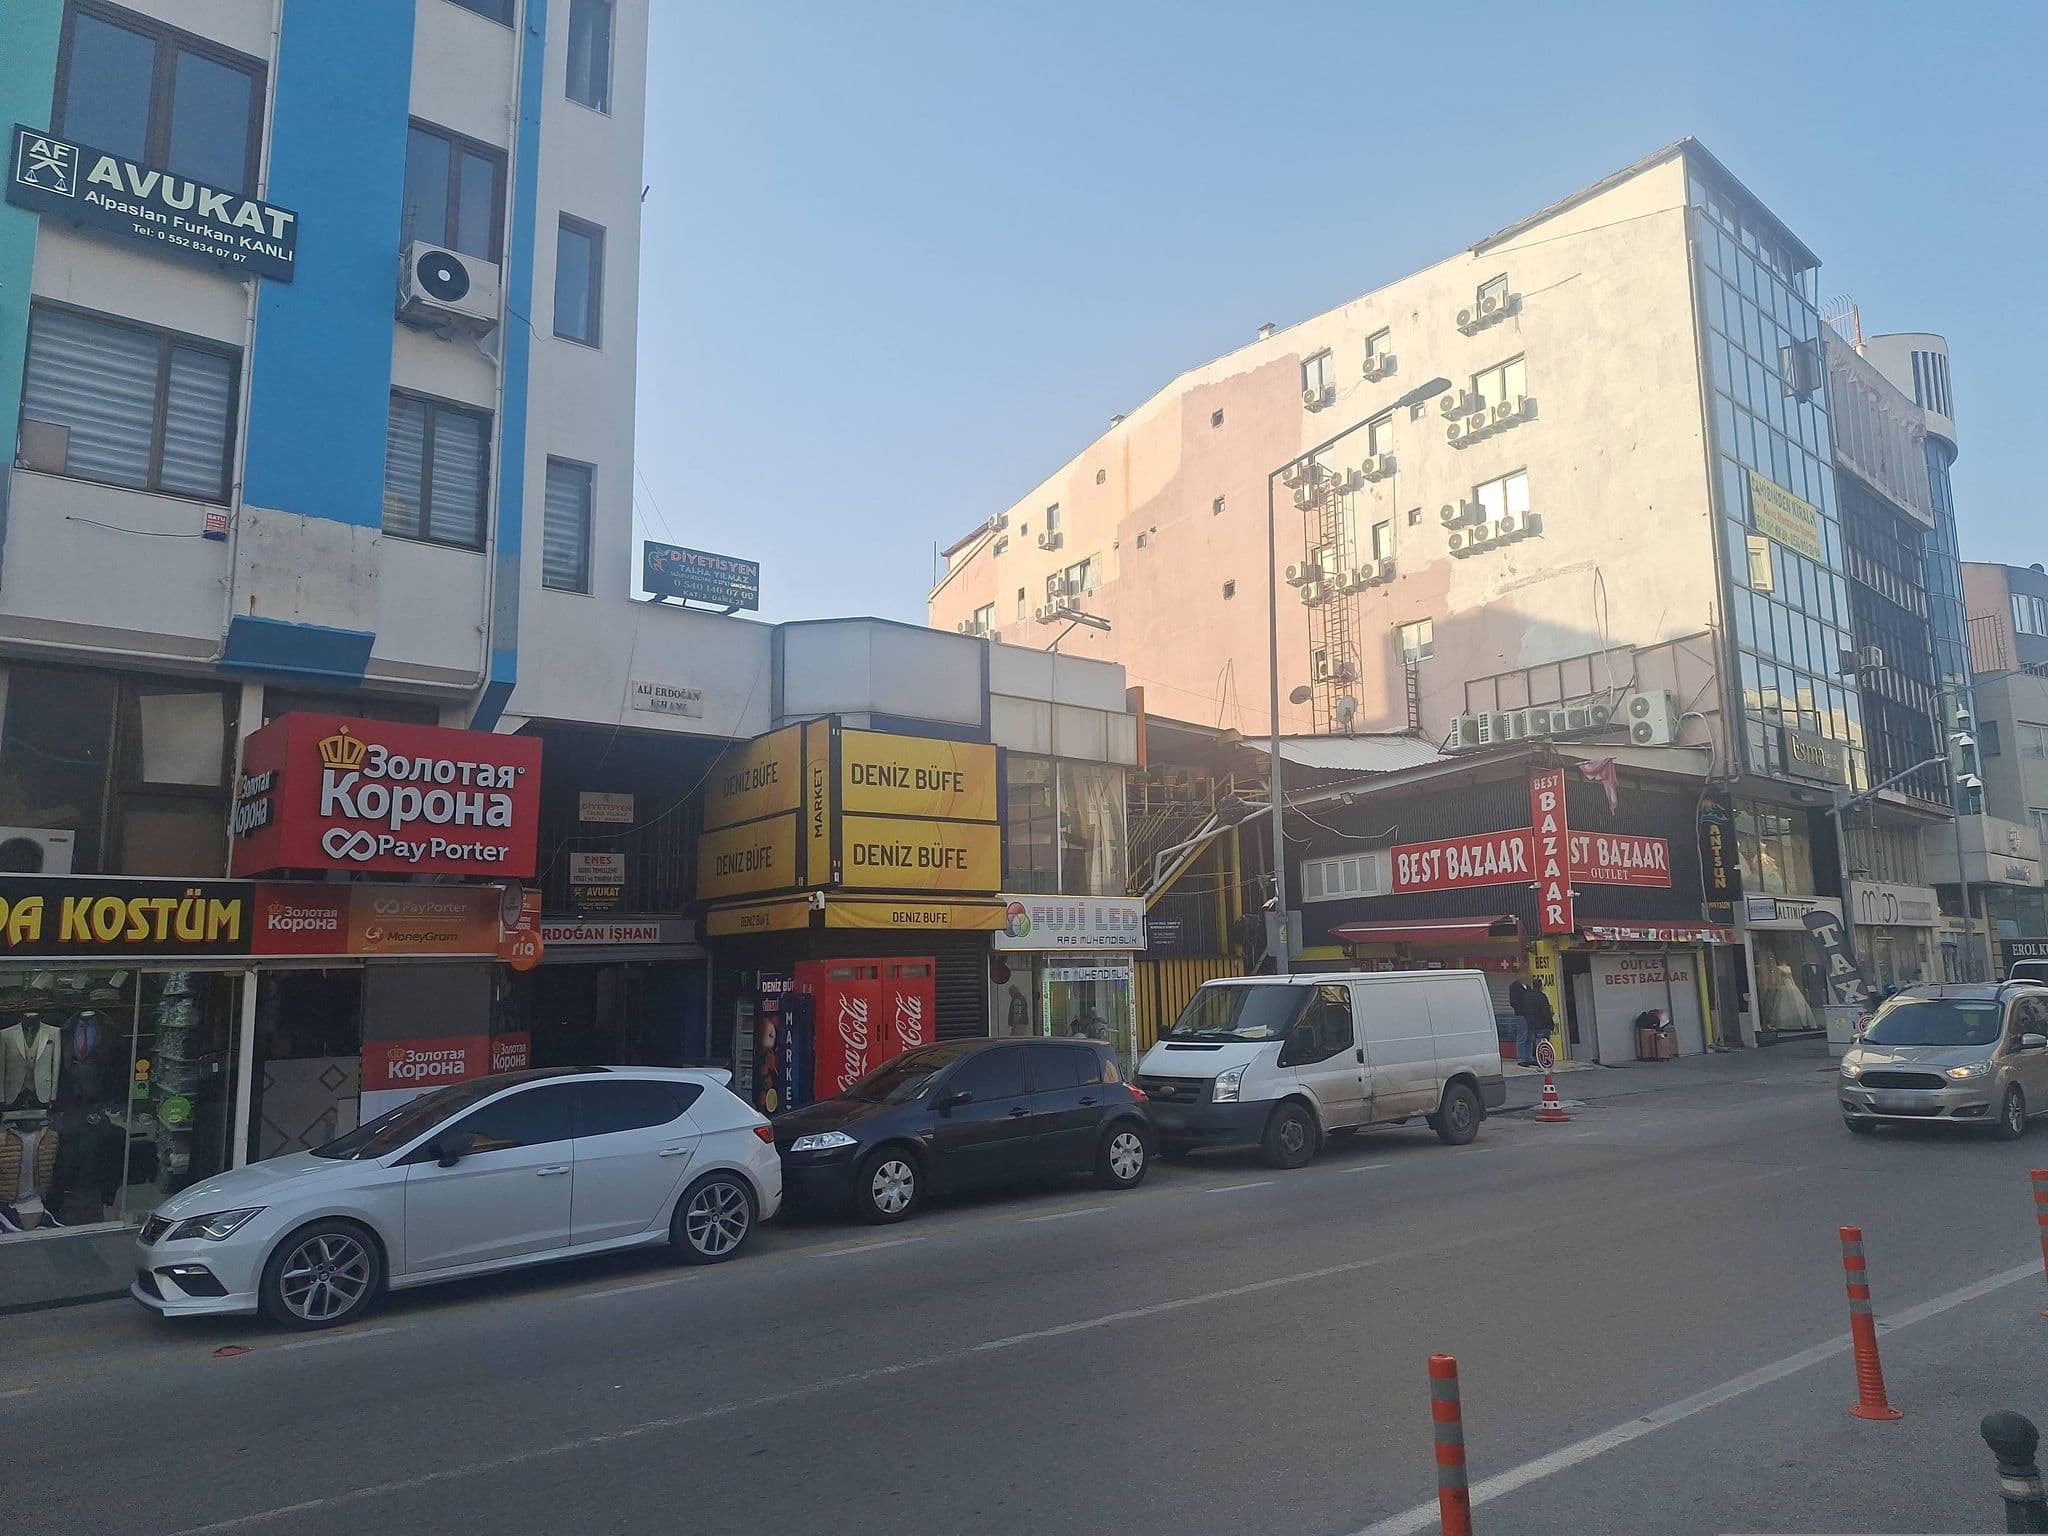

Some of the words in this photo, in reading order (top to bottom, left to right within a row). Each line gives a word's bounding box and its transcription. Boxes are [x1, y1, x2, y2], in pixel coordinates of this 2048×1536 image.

[30, 139, 70, 160] AF
[87, 156, 294, 240] AVUKAT
[85, 190, 167, 225] Alpaslan
[173, 216, 234, 245] Furkan
[240, 235, 293, 262] KANLI
[133, 224, 154, 237] Tel:
[158, 231, 165, 240] 0
[168, 233, 190, 247] 552
[192, 240, 214, 255] 834
[216, 247, 230, 258] 07
[232, 251, 247, 263] 07
[362, 744, 515, 789] Золотая
[752, 760, 778, 789] BÜFE
[851, 761, 911, 789] DENİZ
[915, 765, 964, 793] BÜFE
[1534, 775, 1558, 790] BEST
[320, 769, 513, 831] Корона
[814, 767, 823, 839] MARKET
[230, 798, 267, 837] Корона
[716, 848, 743, 877] DENİZ
[746, 843, 772, 872] BÜFE
[853, 840, 913, 867] DENİZ
[918, 842, 967, 870] BÜFE
[1398, 846, 1441, 885] BEST
[1446, 837, 1528, 881] BAZAAR
[1539, 791, 1564, 926] BAZAAR
[1570, 837, 1590, 864] ST
[1596, 838, 1667, 871] BAZAAR
[1590, 868, 1629, 881] OUTLET
[587, 887, 619, 897] AVUKAT
[58, 888, 241, 943] KOSTÜM
[284, 906, 338, 918] Золотая
[402, 902, 466, 914] PayPorter
[267, 915, 338, 932] Корона
[1095, 907, 1138, 931] LED
[387, 931, 458, 944] MoneyGram
[541, 924, 604, 941] RDOĞAN
[609, 925, 657, 943] İŞHANI
[1057, 936, 1077, 945] RAS
[512, 935, 535, 957] ria
[2012, 943, 2038, 956] EROL
[2039, 943, 2048, 956] K
[1535, 956, 1550, 969] BEST
[1621, 959, 1665, 970] OUTLET
[1812, 923, 1869, 1004] TAX
[762, 978, 782, 993] DENİZ
[782, 977, 796, 992] BÜF
[1605, 973, 1637, 985] BEST
[1639, 971, 1688, 984] BAZAAR
[500, 1043, 526, 1056] Золотая
[837, 992, 868, 1092] Coca-Cola
[406, 1049, 465, 1063] Золотая
[492, 1054, 526, 1072] Корона
[388, 1060, 465, 1081] Корона
